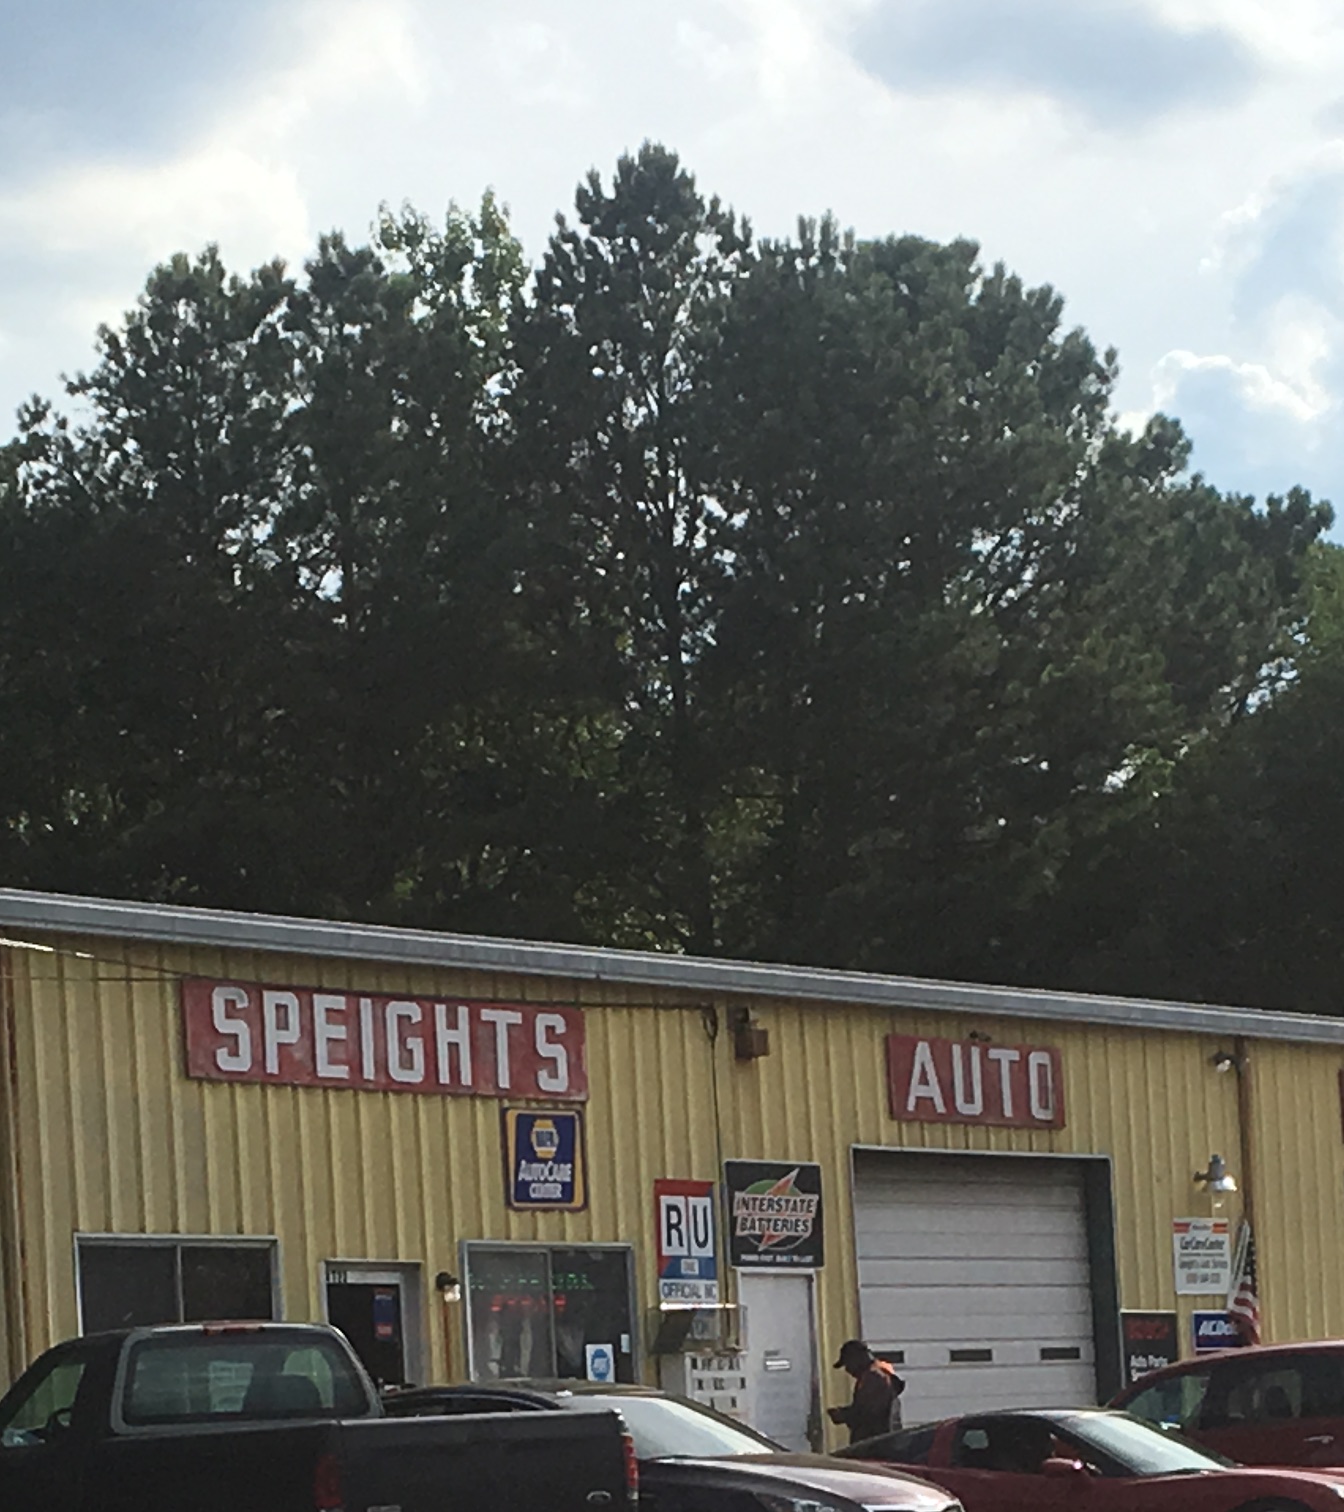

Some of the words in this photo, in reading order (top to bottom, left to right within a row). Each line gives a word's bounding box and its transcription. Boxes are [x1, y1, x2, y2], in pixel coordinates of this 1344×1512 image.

[212, 986, 568, 1092] SPEIGHTS
[907, 1041, 1054, 1120] AUTO
[736, 1196, 814, 1214] INTERSTATE
[739, 1217, 810, 1233] BATTERIES
[662, 1283, 701, 1299] OFFICIAL
